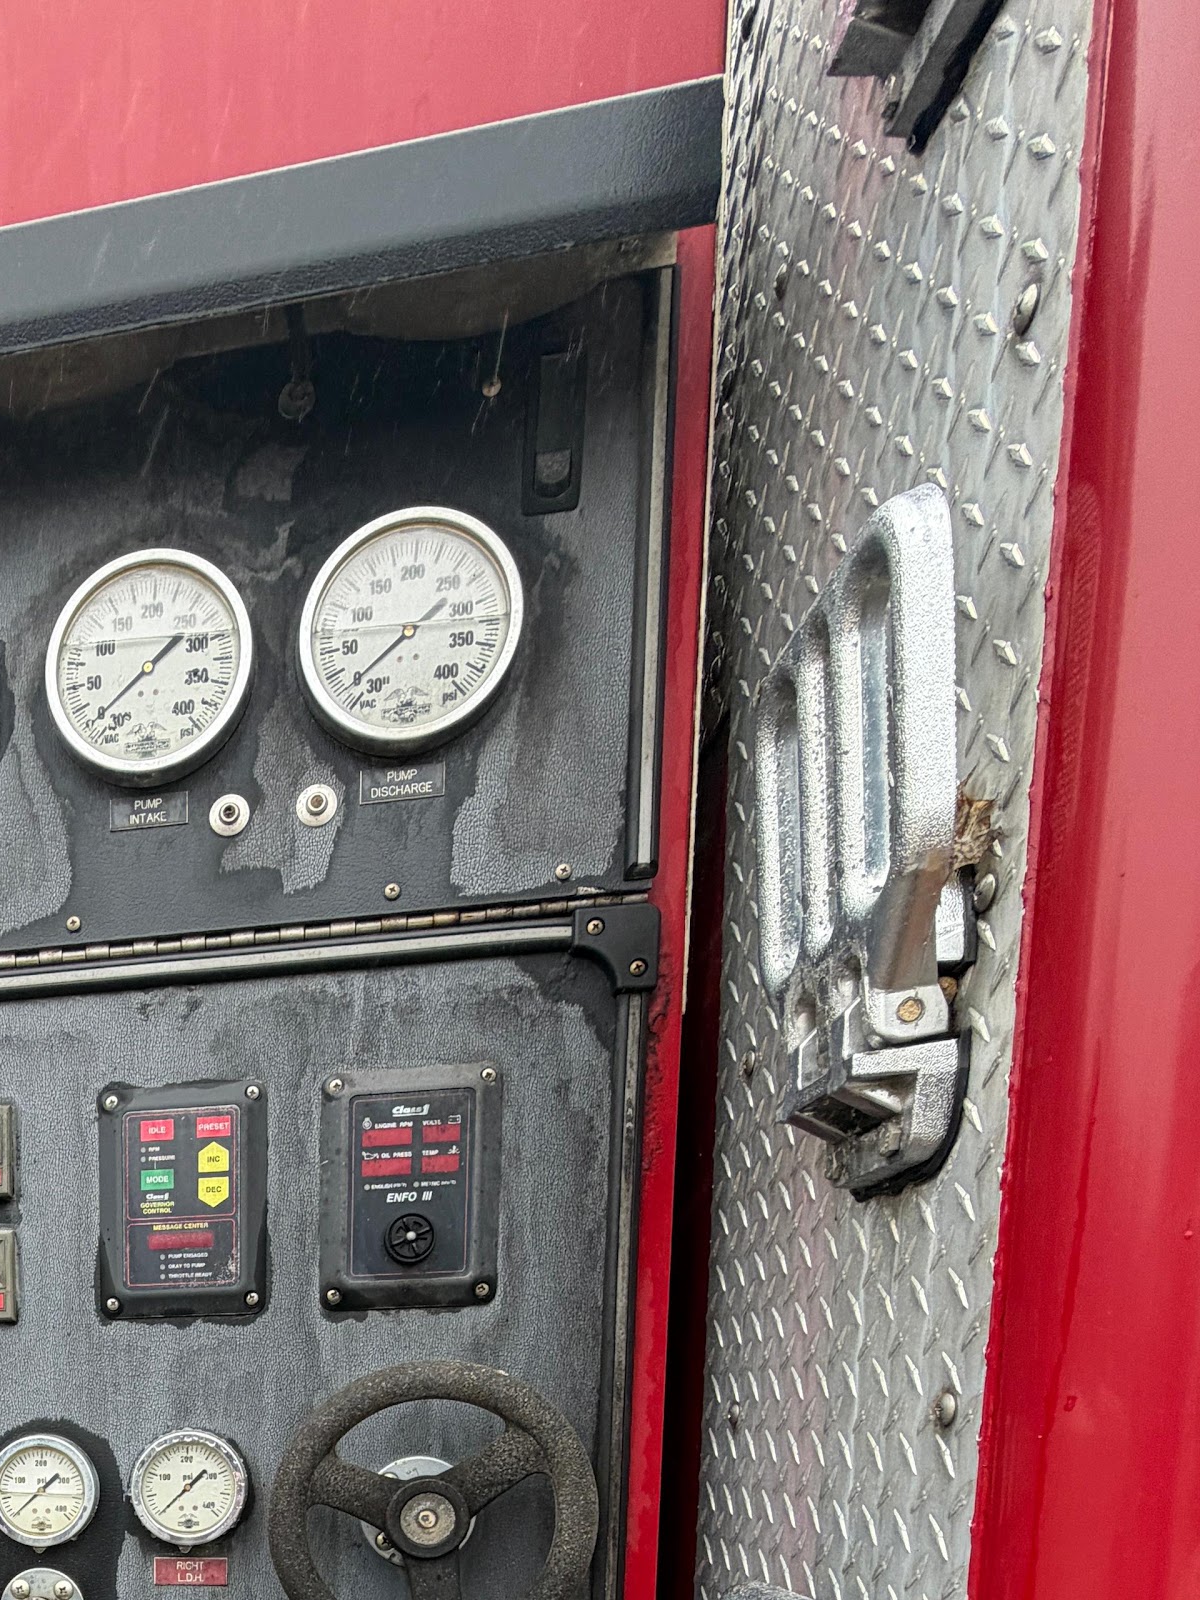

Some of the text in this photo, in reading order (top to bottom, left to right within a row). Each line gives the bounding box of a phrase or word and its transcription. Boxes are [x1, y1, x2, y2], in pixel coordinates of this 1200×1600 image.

[401, 563, 426, 581] 200
[369, 578, 392, 595] 150
[436, 575, 461, 592] 250
[141, 602, 163, 619] 200
[350, 606, 374, 623] 100
[449, 600, 473, 617] 300
[111, 616, 133, 632] 150
[173, 613, 197, 630] 250
[185, 636, 209, 653] 300
[449, 630, 474, 648] 350
[341, 639, 358, 655] 50
[433, 662, 459, 680] 400
[86, 675, 102, 691] 50
[171, 699, 195, 715] 400
[359, 699, 376, 710] VAC
[386, 769, 418, 781] PUMP
[370, 781, 433, 798] DISCHARGE
[133, 798, 163, 810] PUMP
[129, 811, 167, 823] INTAKE
[148, 1125, 166, 1134] IDLE
[198, 1122, 230, 1131] PRESET
[145, 1175, 169, 1184] MODE
[386, 1191, 433, 1203] ENFO III
[140, 1201, 175, 1209] GOVERNOR
[142, 1207, 172, 1215] CONTROL
[153, 1222, 209, 1231] MESSAGE CENTER
[34, 1460, 48, 1468] 200
[158, 1473, 171, 1481] 100
[54, 1505, 67, 1513] 400
[176, 1560, 204, 1571] RIGHT
